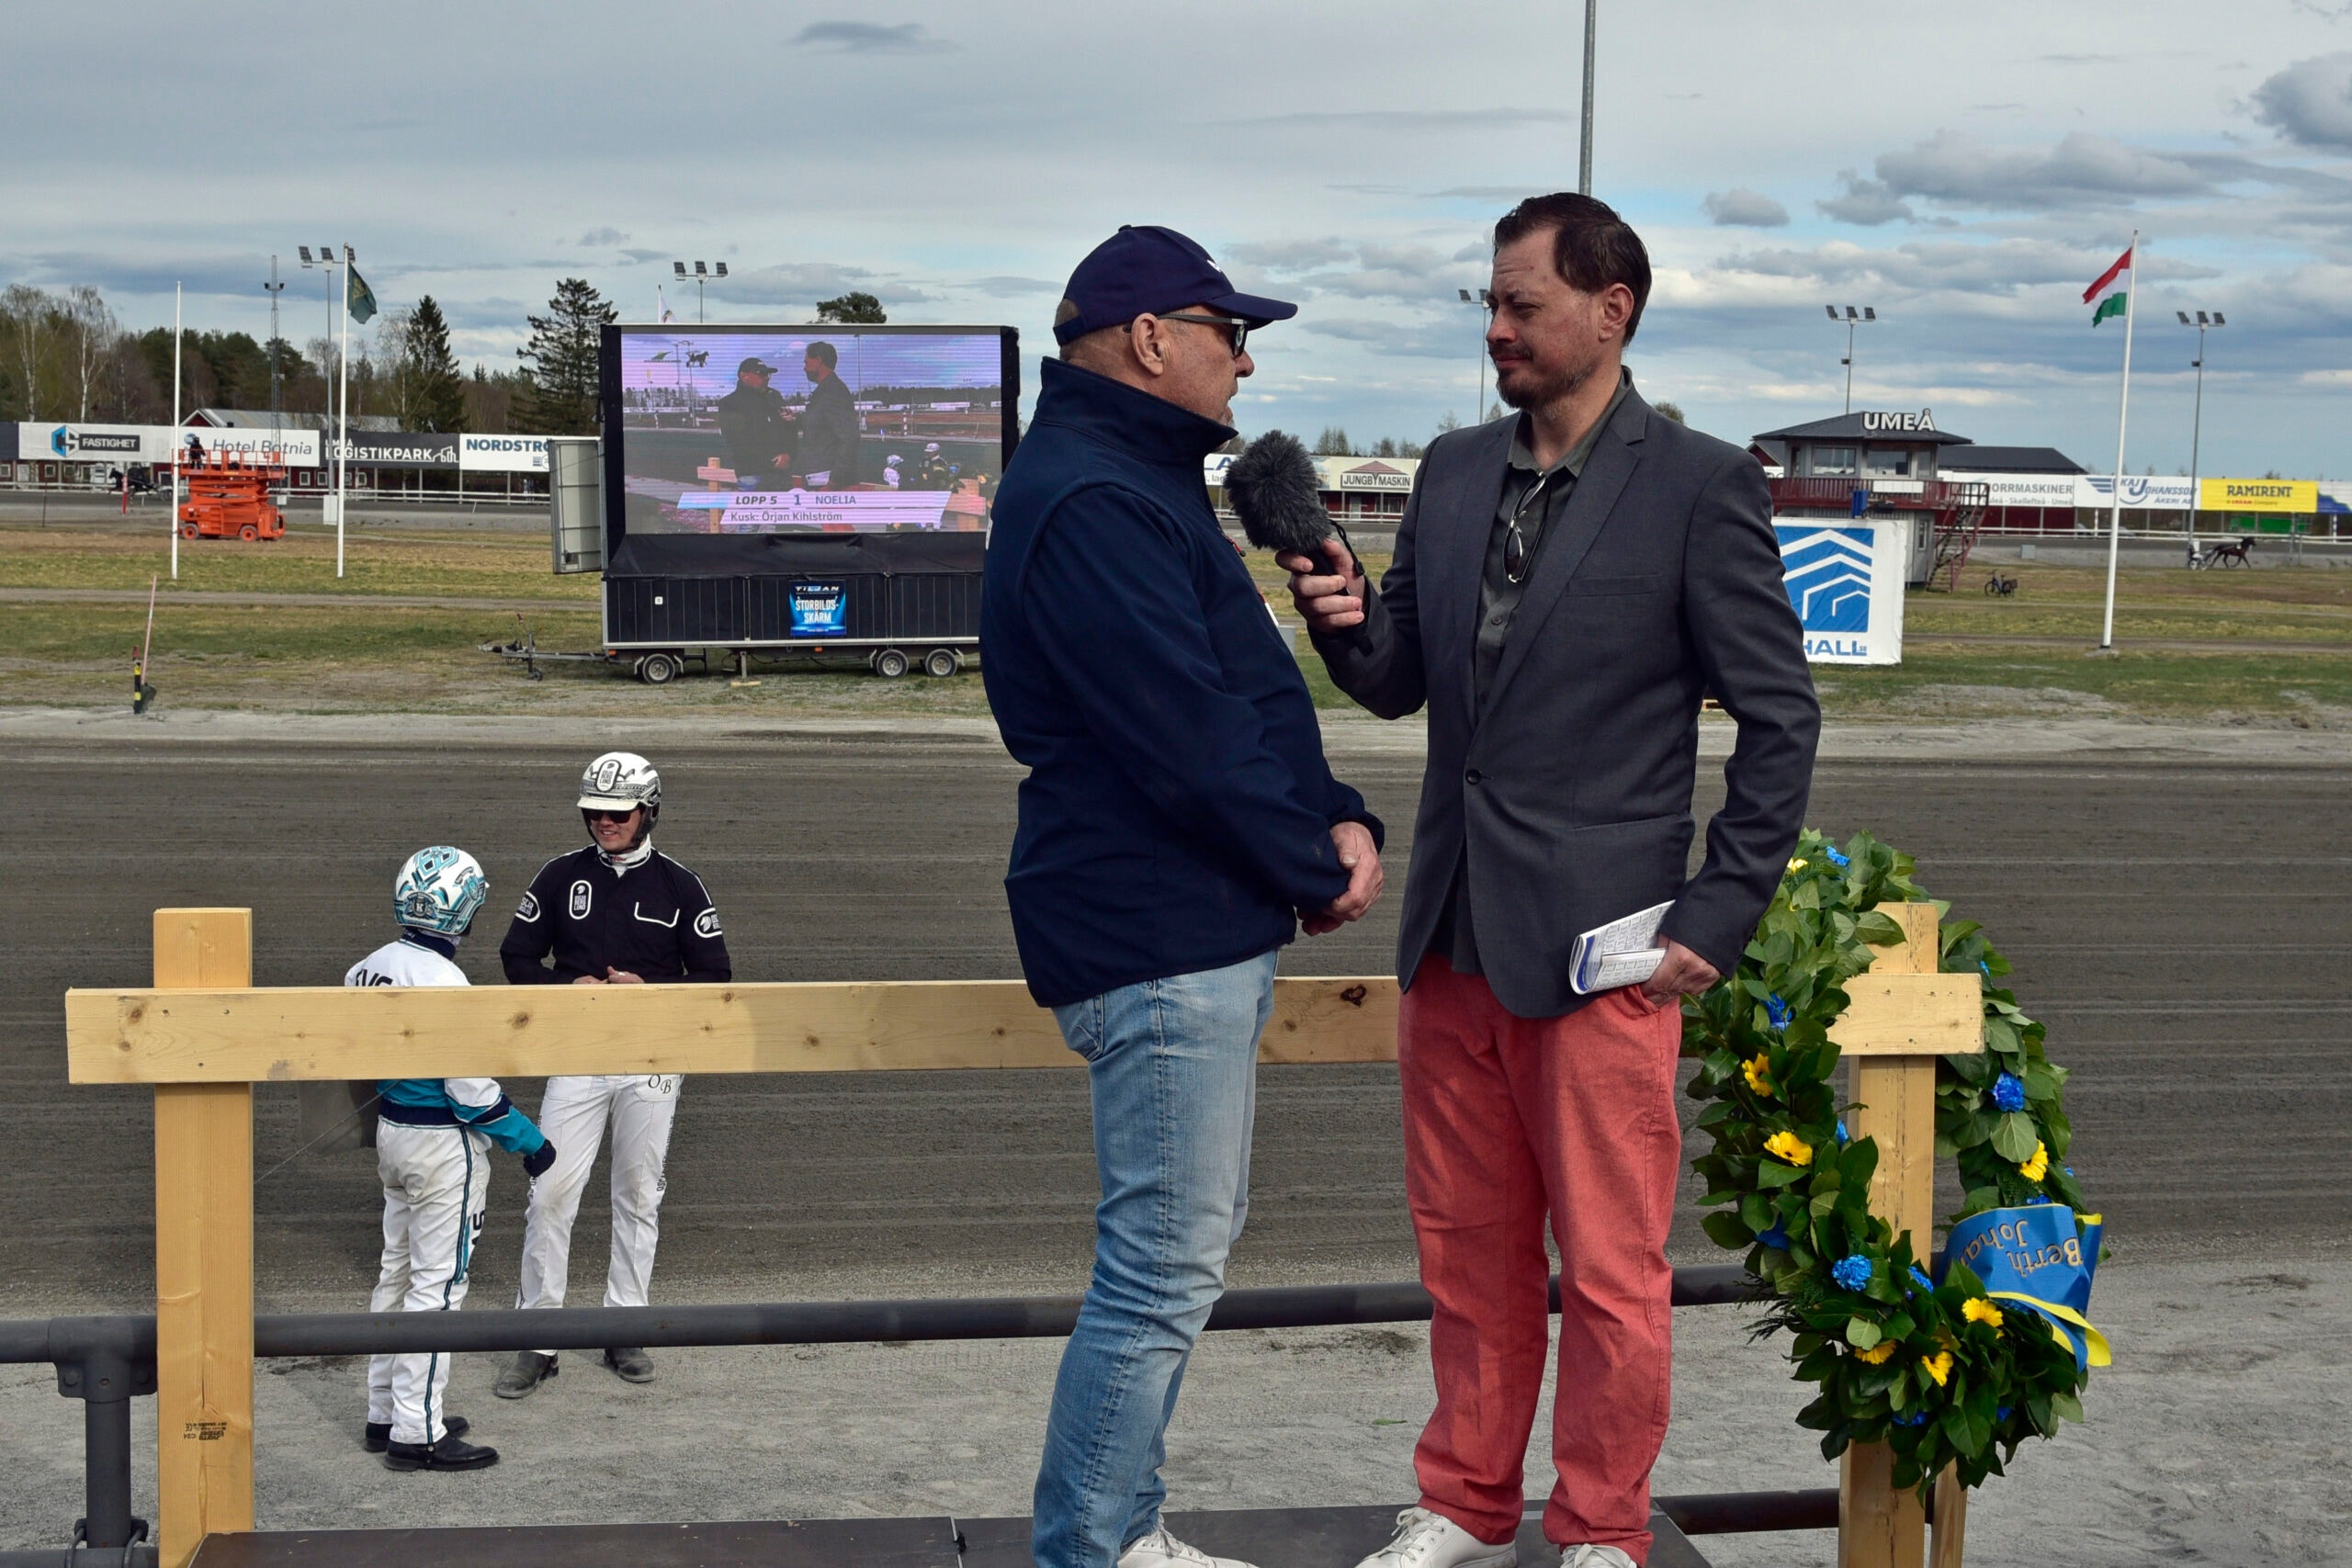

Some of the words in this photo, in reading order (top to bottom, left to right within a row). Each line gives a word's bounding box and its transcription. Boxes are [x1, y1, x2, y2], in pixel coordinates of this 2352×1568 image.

[1862, 408, 1936, 431] UMEÅ
[82, 438, 136, 448] FASTIGHET
[212, 439, 255, 452] Hotel
[261, 441, 312, 455] Botnia
[2120, 478, 2140, 487] KAJ
[2227, 485, 2292, 497] RAMIRENT
[735, 495, 766, 505] LOPP
[769, 495, 778, 505] 5
[793, 494, 802, 506] 1
[815, 495, 856, 505] NOELIA
[730, 512, 759, 522] Kusk:
[762, 510, 789, 523] Örjan
[792, 511, 842, 522] Kihlström
[804, 610, 832, 625] SKÄRM
[2007, 1236, 2084, 1278] Berth
